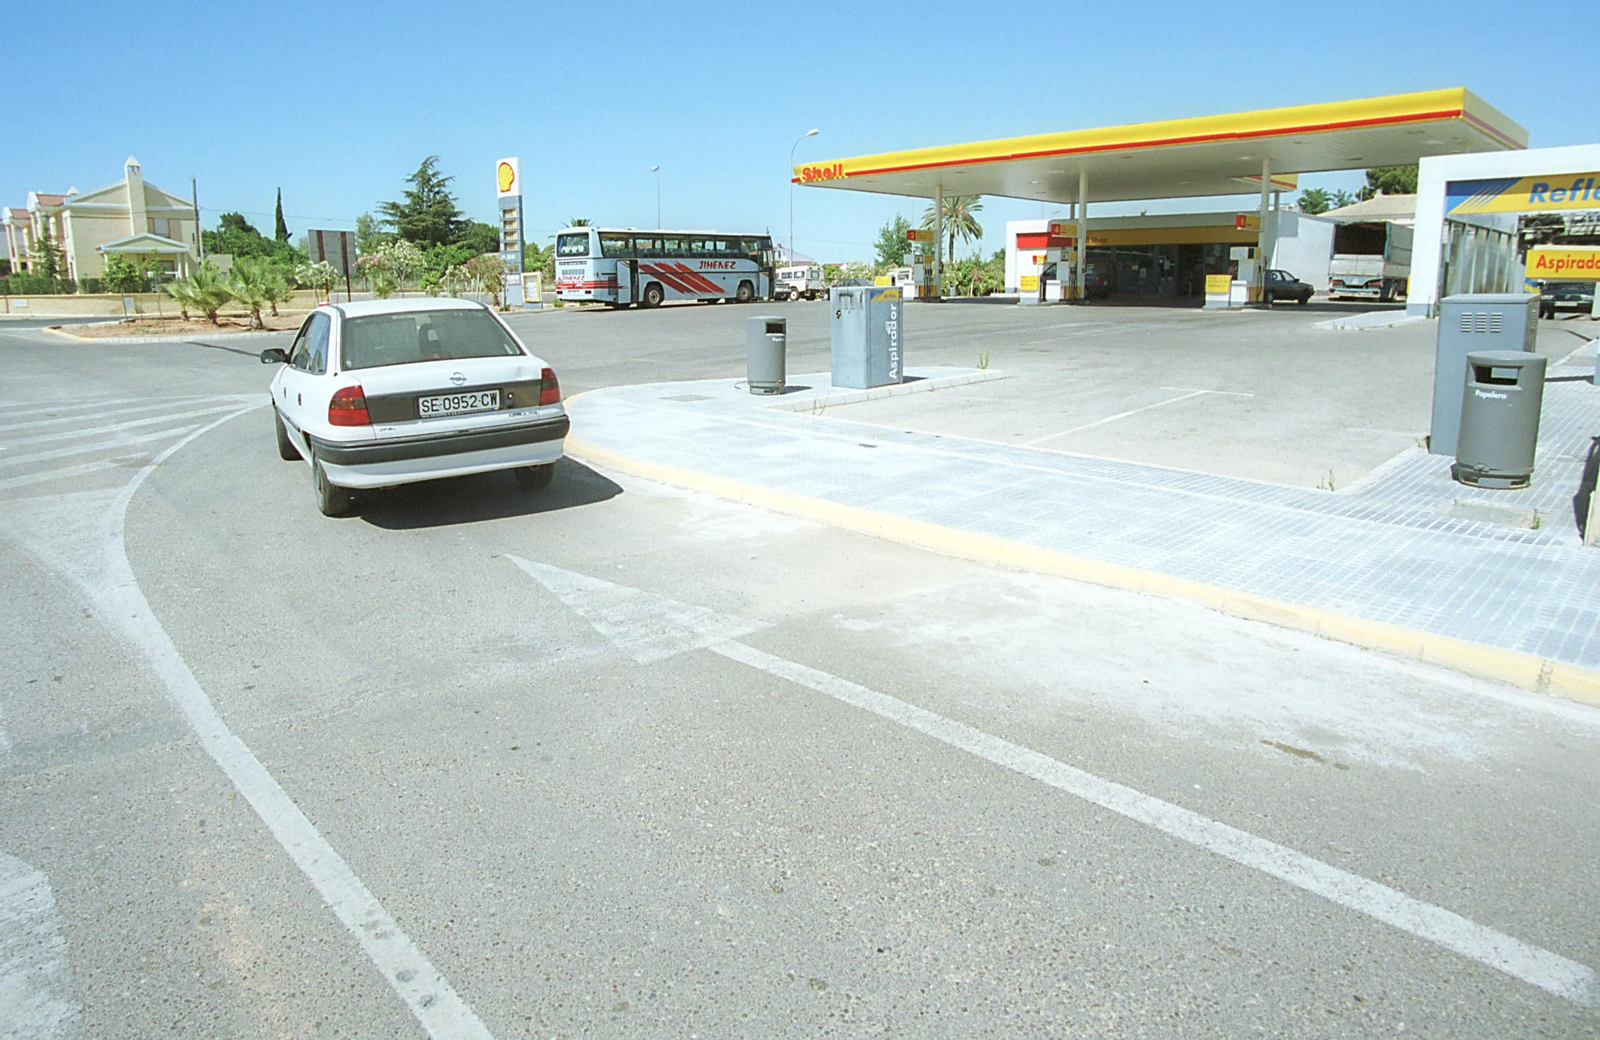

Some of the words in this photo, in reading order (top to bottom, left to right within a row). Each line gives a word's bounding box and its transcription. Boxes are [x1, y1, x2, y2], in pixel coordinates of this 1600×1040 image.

[802, 164, 843, 181] Shell
[699, 260, 737, 270] JIMENEZ
[889, 303, 899, 380] Aspirador
